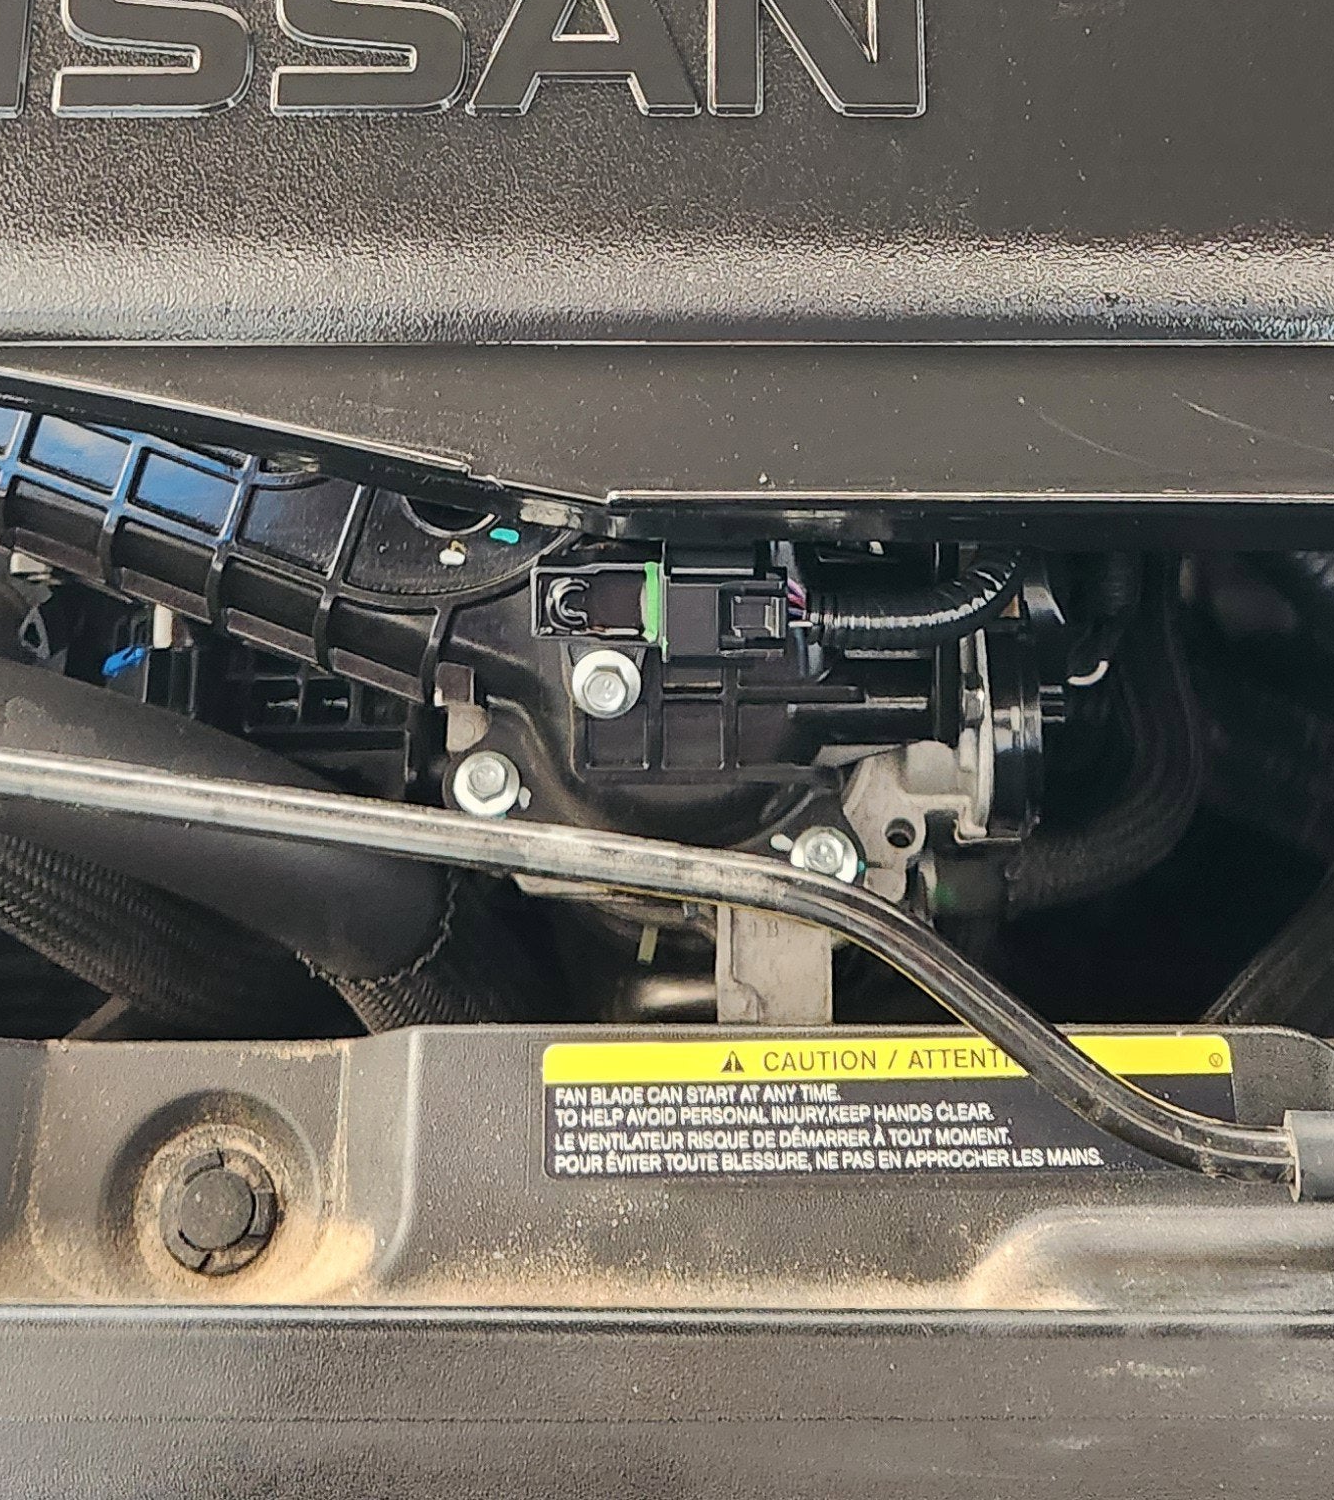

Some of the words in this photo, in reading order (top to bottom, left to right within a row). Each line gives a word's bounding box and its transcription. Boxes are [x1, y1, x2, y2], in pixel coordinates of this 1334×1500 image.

[763, 1049, 876, 1072] CAUTION
[908, 1047, 1017, 1070] ATTENTI
[555, 1086, 587, 1107] FAN
[590, 1086, 644, 1106] BLADE
[647, 1085, 683, 1105] CAN
[686, 1085, 737, 1104] START
[739, 1084, 761, 1103] AT
[763, 1083, 799, 1103] ANY
[800, 1082, 842, 1102] TIME.
[555, 1108, 579, 1128] TO
[581, 1107, 624, 1128] HELP
[625, 1106, 677, 1127] AVOID
[679, 1105, 770, 1126] PERSONAL
[873, 1102, 934, 1123] HANDS
[935, 1100, 996, 1122] CLEAR.
[555, 1131, 575, 1152] LE
[577, 1130, 685, 1151] VENTILATEUR
[687, 1130, 751, 1151] RISQUE
[752, 1129, 777, 1150] DE
[778, 1124, 871, 1149] DÉMARRER
[872, 1123, 886, 1148] À
[889, 1127, 932, 1148] TOUT
[935, 1126, 1014, 1147] MOMENT.
[555, 1154, 604, 1175] POUR
[605, 1149, 663, 1174] ÉVITER
[666, 1153, 719, 1173] TOUTE
[720, 1151, 814, 1174] BLESSURE,
[815, 1151, 839, 1171] NE
[841, 1151, 876, 1170] PAS
[877, 1150, 902, 1170] EN
[903, 1149, 1010, 1169] APPROCHER
[1012, 1148, 1045, 1168] LES
[1046, 1147, 1105, 1167] MAINS.
